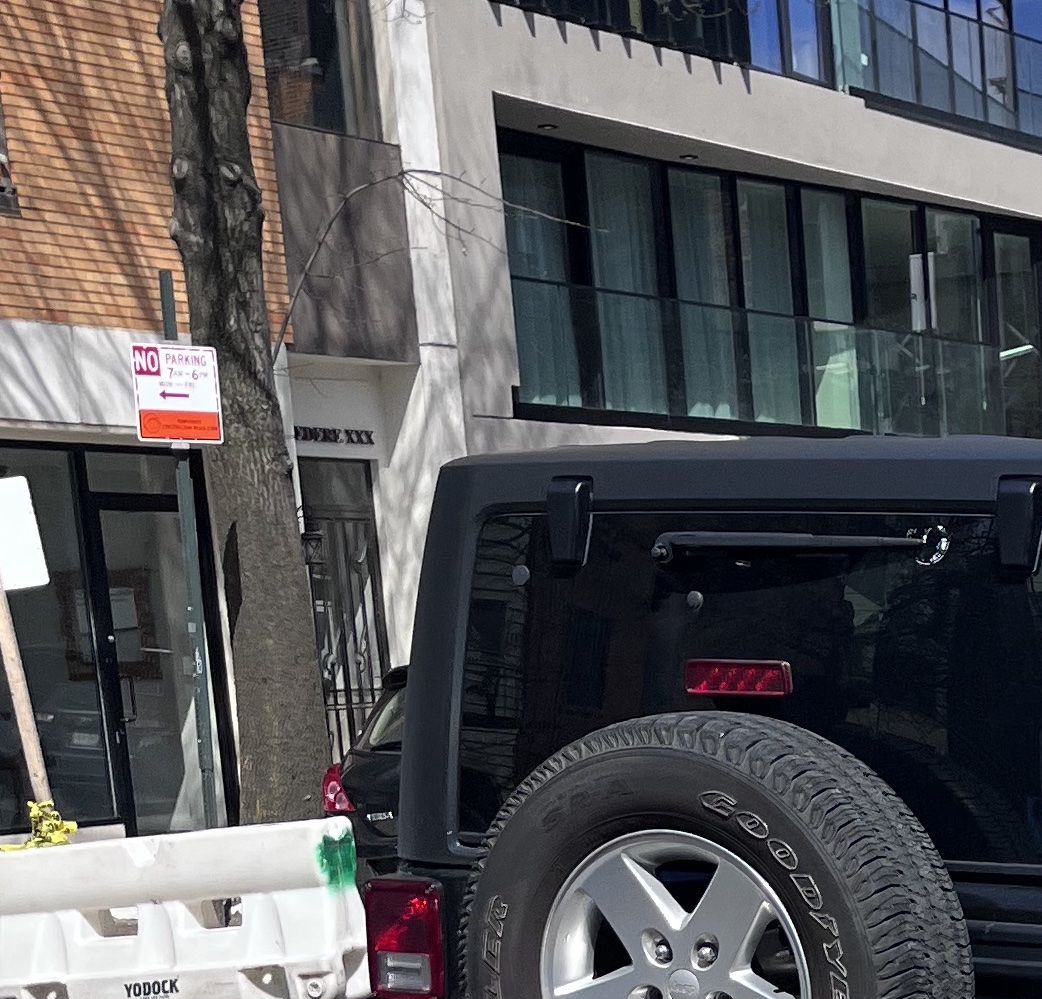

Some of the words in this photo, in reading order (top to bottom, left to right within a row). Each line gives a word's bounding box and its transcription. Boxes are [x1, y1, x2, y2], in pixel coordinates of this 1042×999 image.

[134, 349, 159, 373] NO
[165, 353, 207, 367] PARKING
[343, 429, 375, 445] XXX
[123, 978, 179, 998] YODOCK
